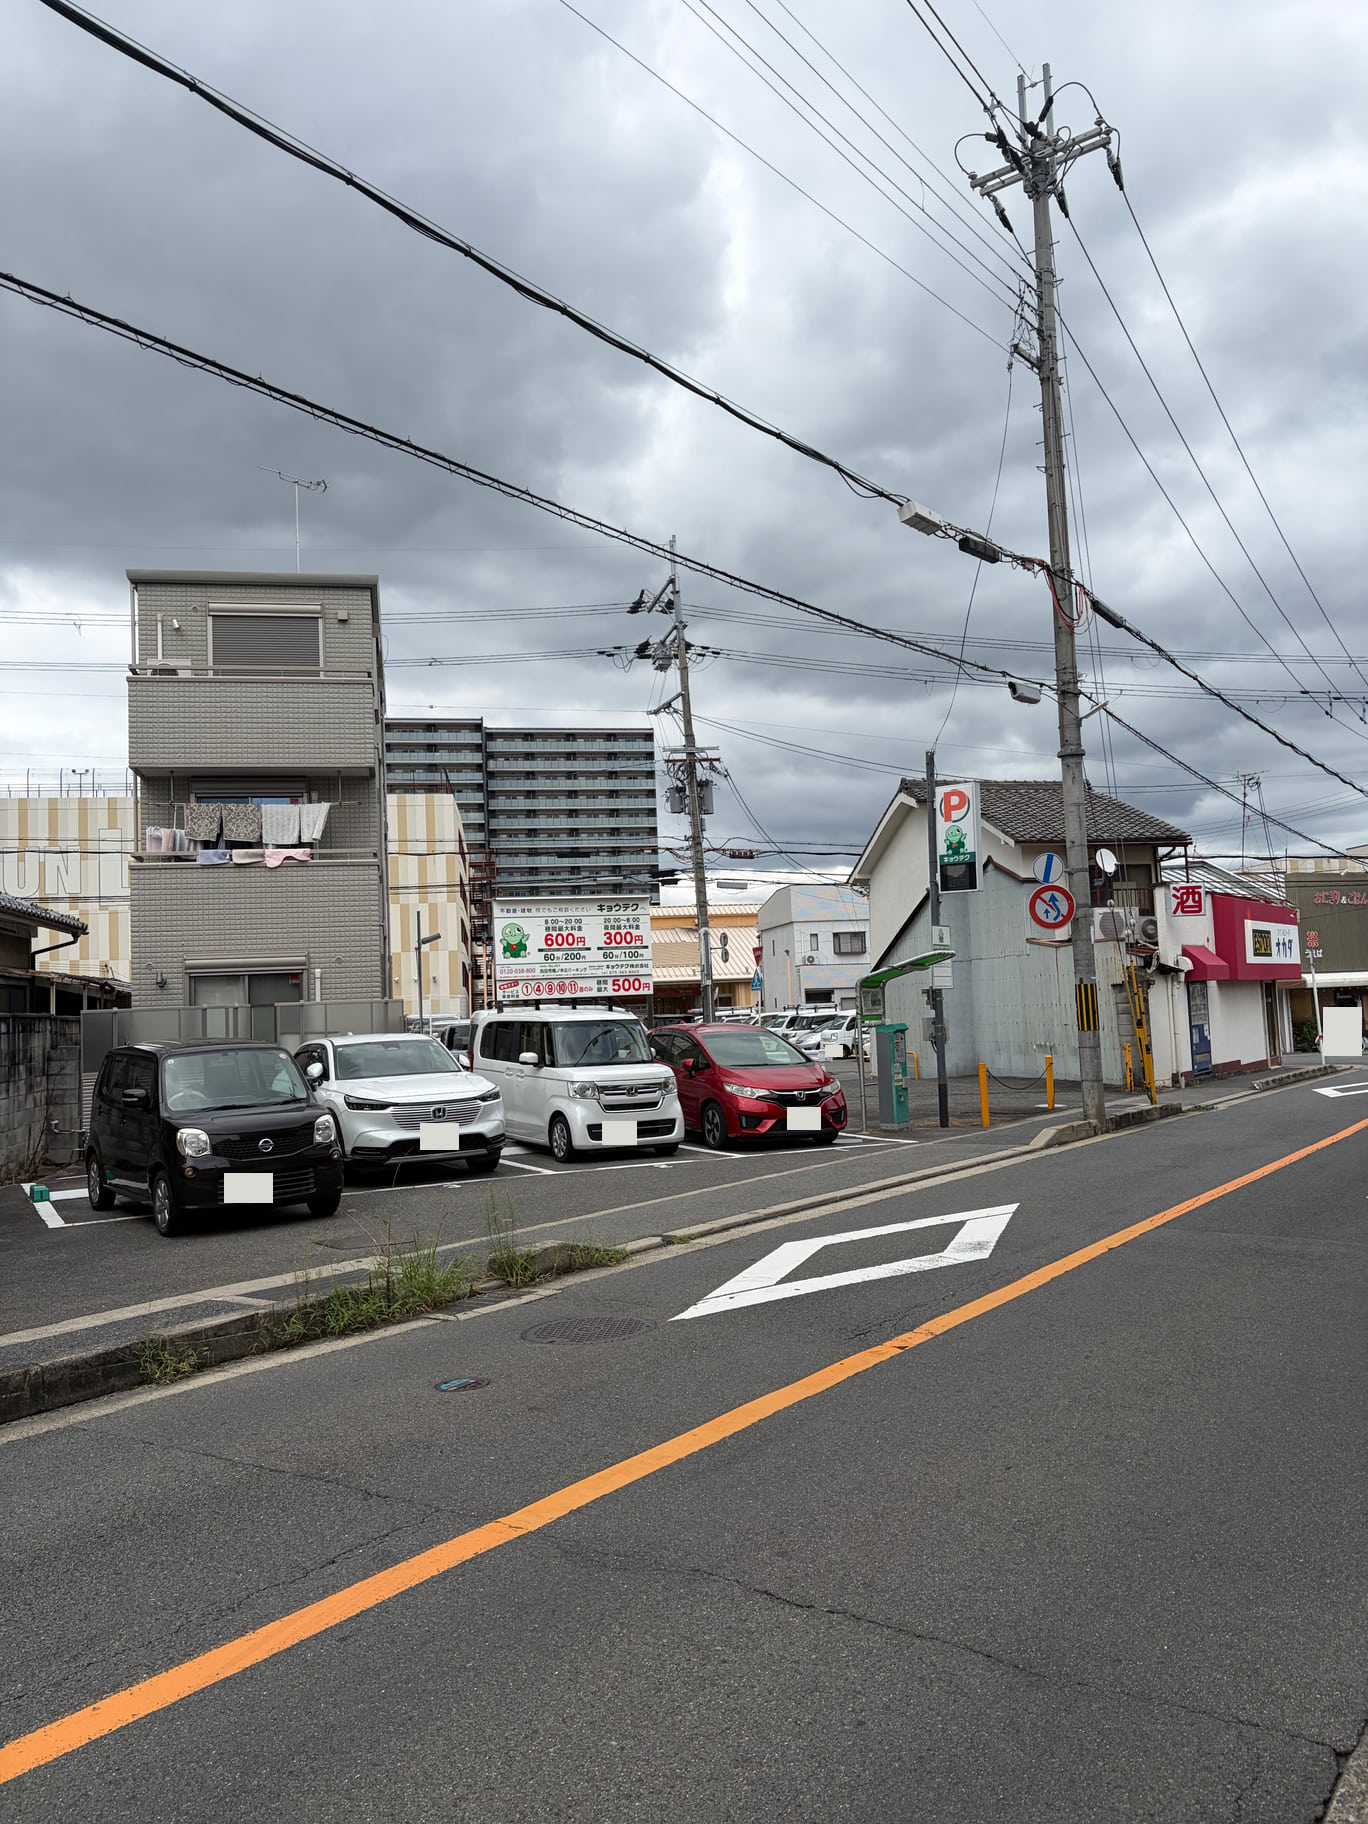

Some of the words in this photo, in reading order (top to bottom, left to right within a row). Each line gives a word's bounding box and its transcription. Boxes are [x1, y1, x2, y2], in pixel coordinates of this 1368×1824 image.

[943, 790, 967, 822] P
[944, 854, 970, 862] キョウテク
[1172, 885, 1202, 914] 酒
[544, 932, 586, 947] 600円
[603, 931, 644, 946] 300円
[1276, 937, 1293, 960] オカダ
[612, 977, 651, 993] 500円
